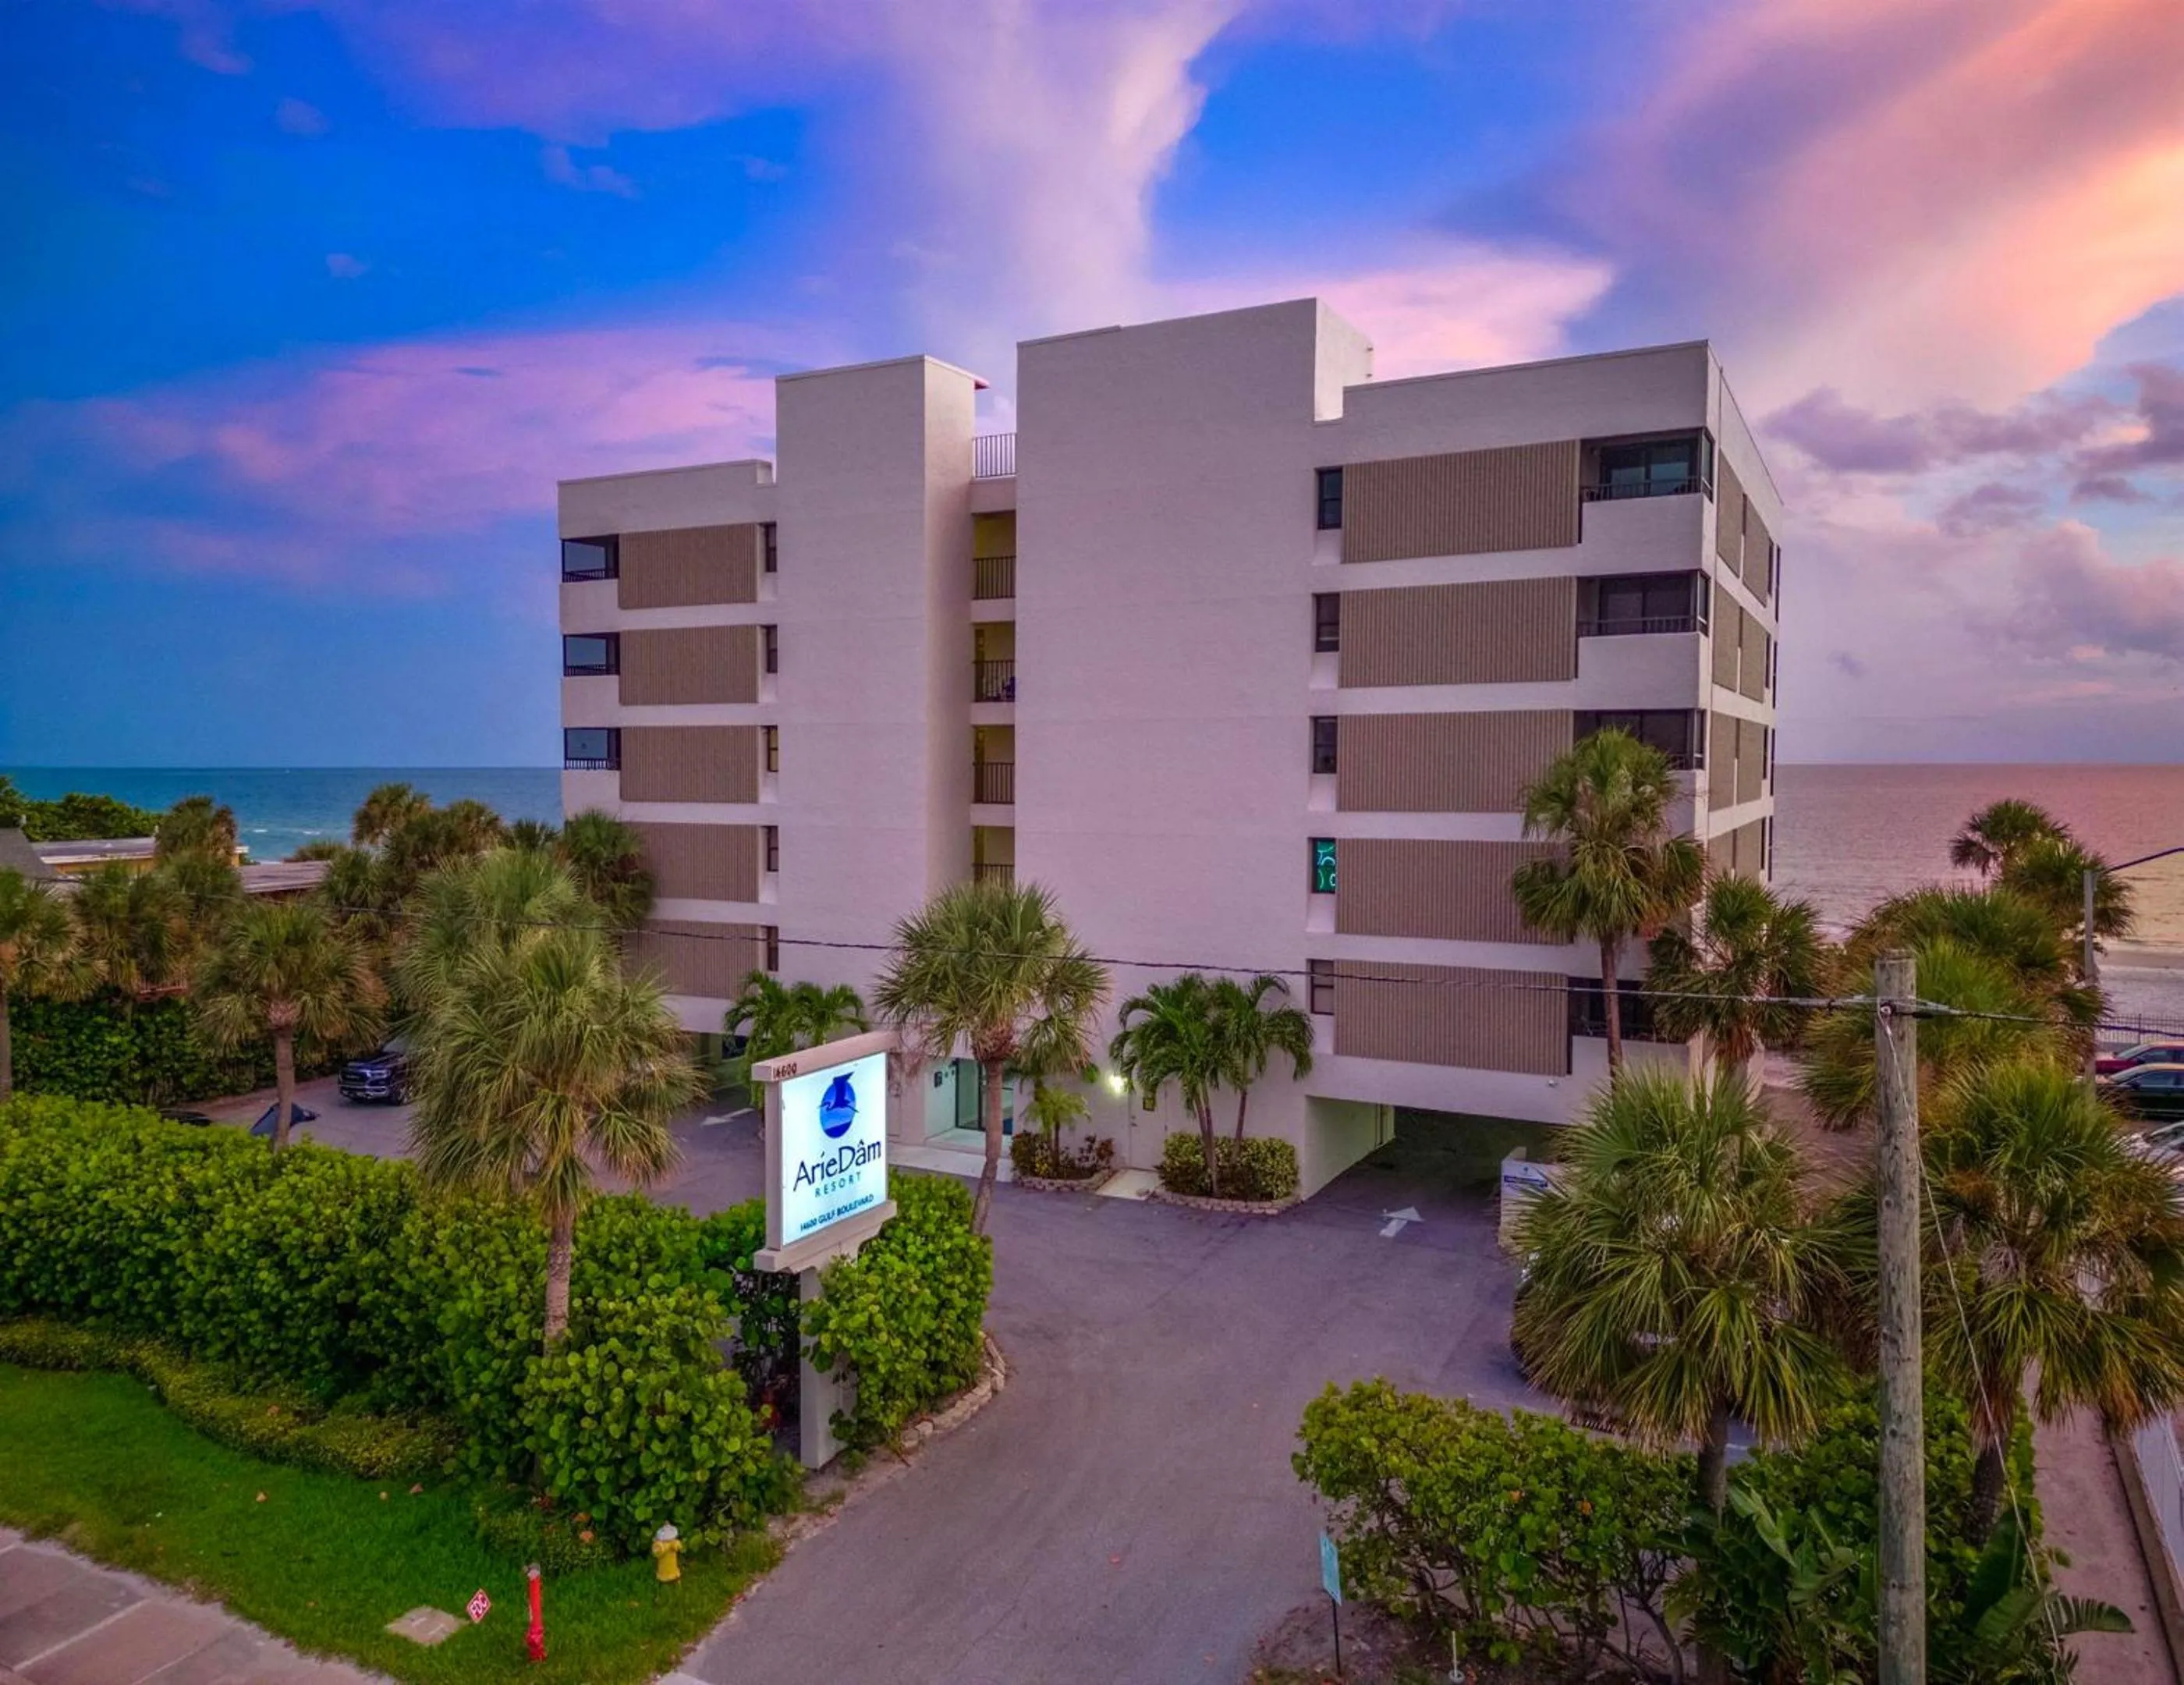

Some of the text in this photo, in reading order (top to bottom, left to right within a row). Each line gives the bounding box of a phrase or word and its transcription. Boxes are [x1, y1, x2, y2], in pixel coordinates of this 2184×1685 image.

[815, 1172, 861, 1197] RESORT
[818, 1210, 835, 1223] GULF
[837, 1194, 874, 1216] BOULEVARD
